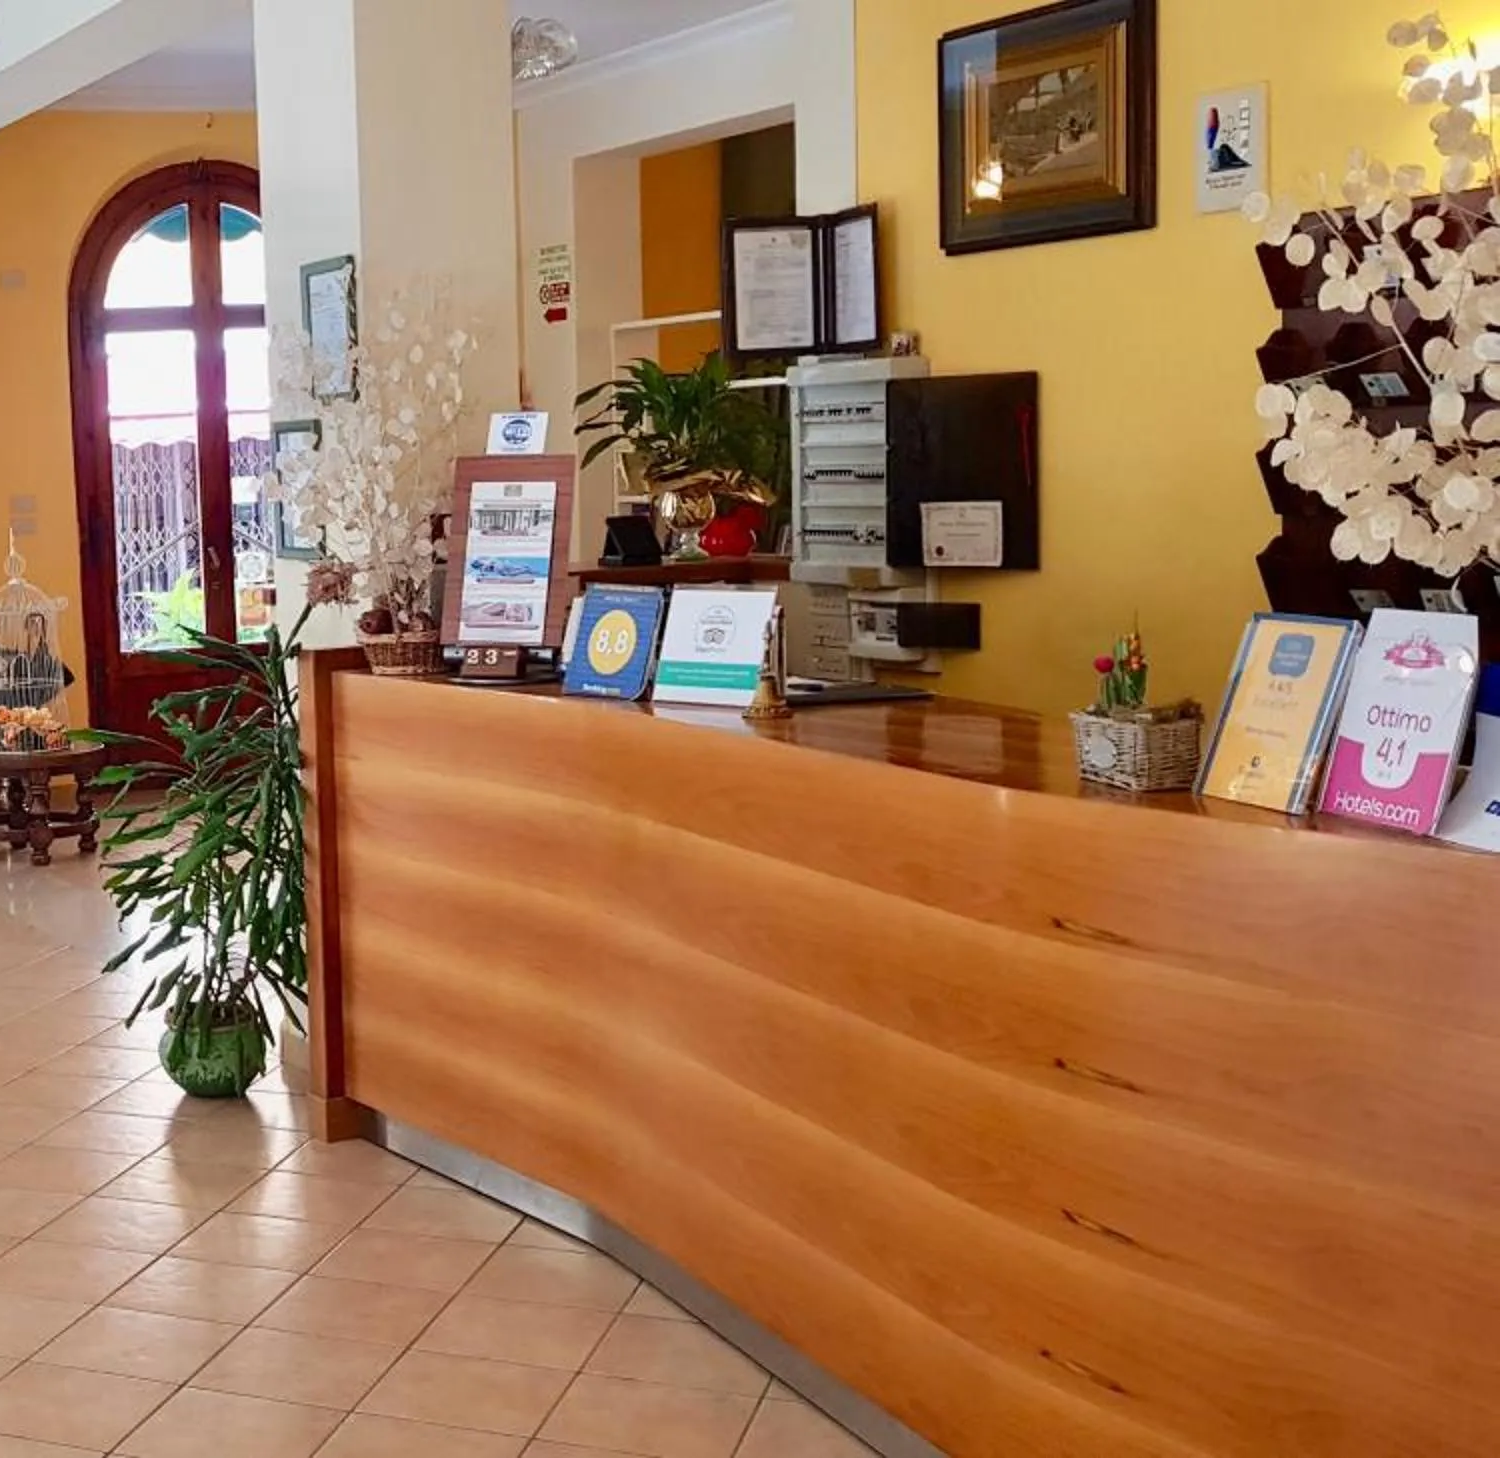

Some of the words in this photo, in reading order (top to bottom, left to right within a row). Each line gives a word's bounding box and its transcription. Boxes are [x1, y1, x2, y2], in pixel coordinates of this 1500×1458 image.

[1367, 704, 1432, 733] Ottimo
[1376, 737, 1407, 768] 4,1
[1333, 790, 1420, 825] Hotels.com
